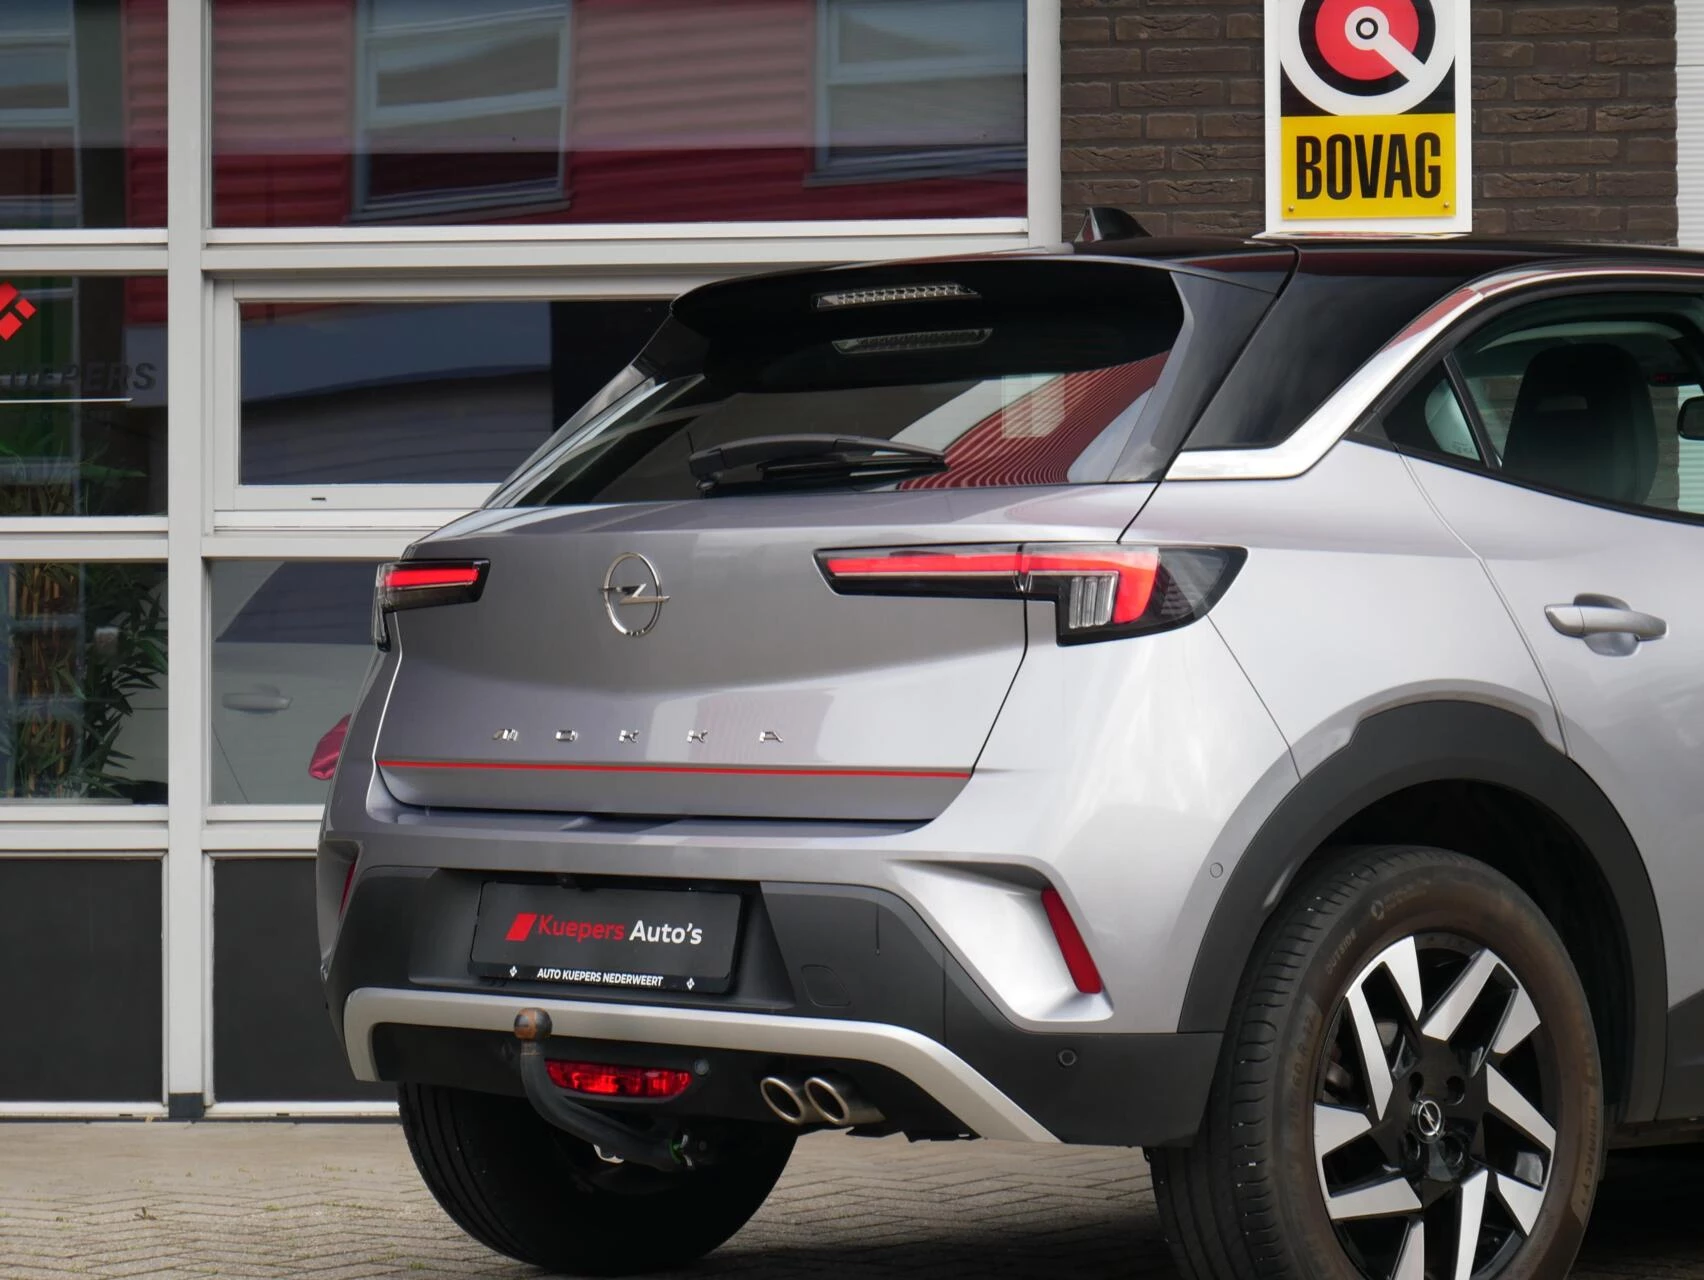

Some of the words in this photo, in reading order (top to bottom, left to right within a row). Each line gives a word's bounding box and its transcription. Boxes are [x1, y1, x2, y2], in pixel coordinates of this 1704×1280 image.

[1296, 132, 1441, 200] BOVAG
[0, 362, 157, 391] UEPERS
[538, 914, 625, 943] Kuepers
[629, 919, 703, 945] Auto's
[1326, 927, 1358, 975] OUTSIDE
[537, 967, 561, 979] AUTO
[562, 969, 601, 983] KUEPERS
[602, 972, 664, 987] NEDERWEERT
